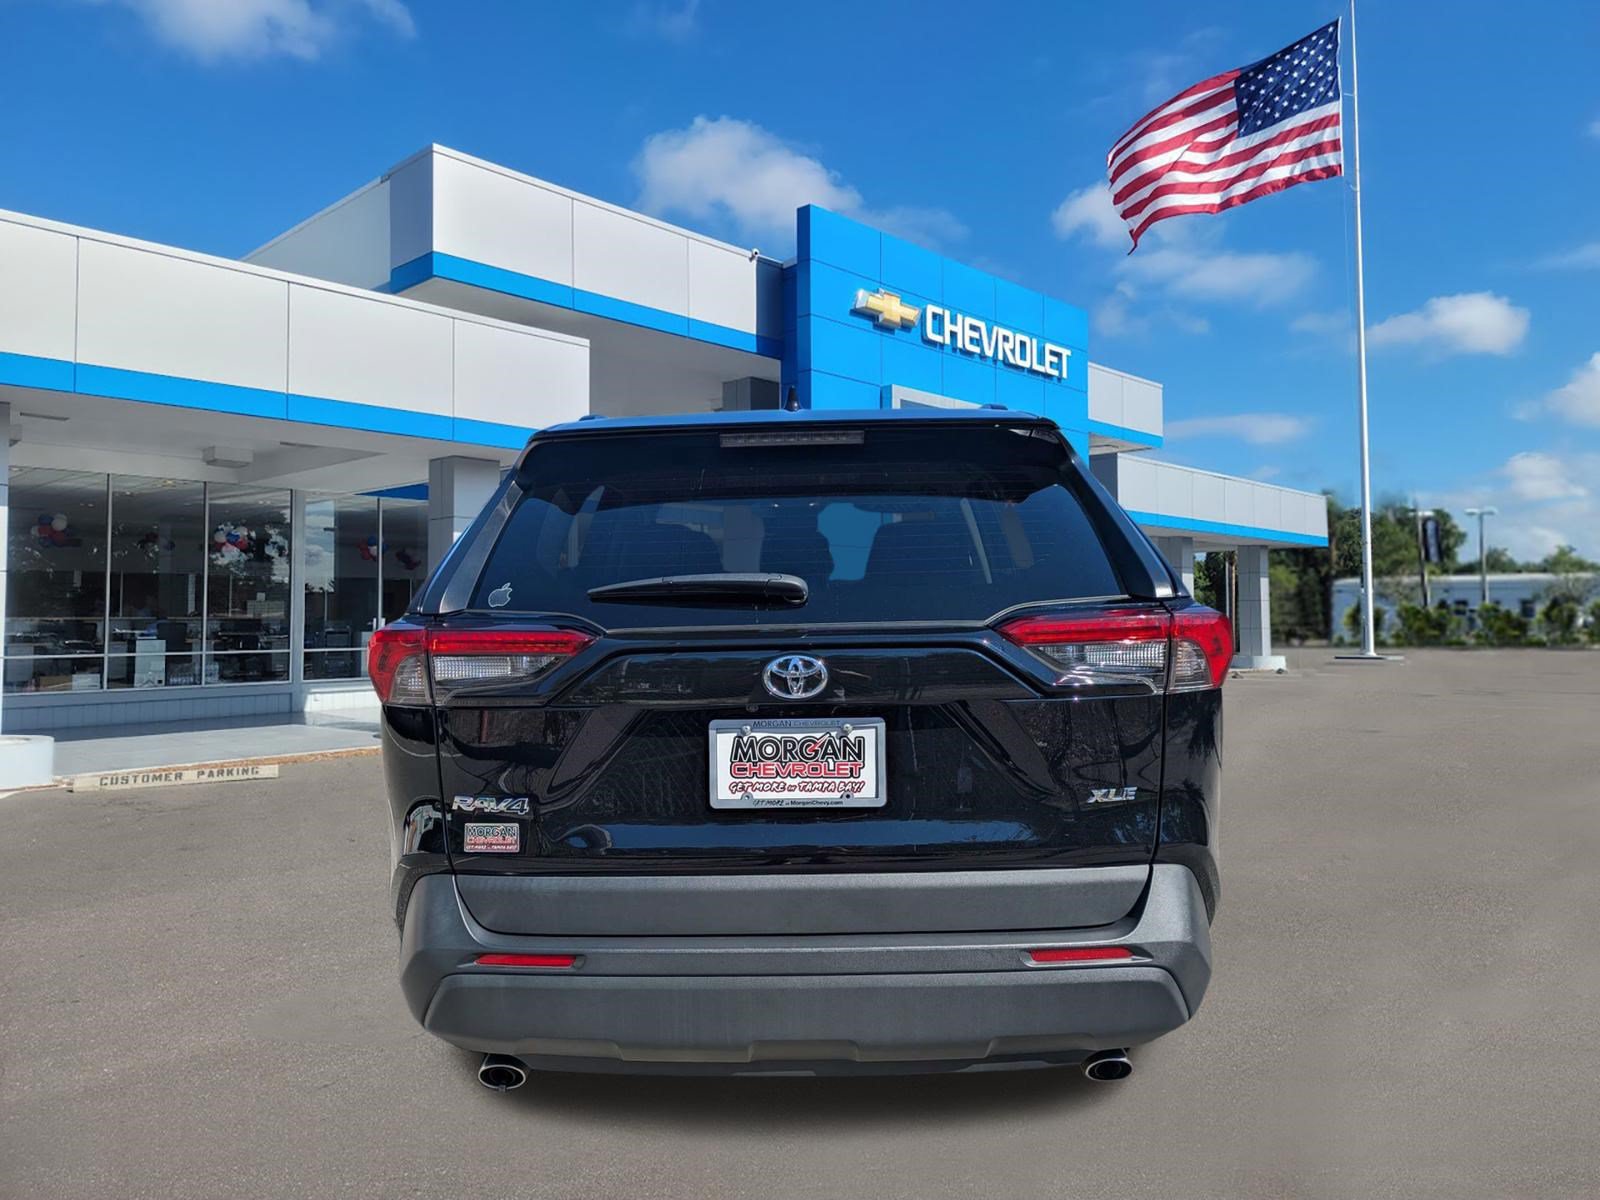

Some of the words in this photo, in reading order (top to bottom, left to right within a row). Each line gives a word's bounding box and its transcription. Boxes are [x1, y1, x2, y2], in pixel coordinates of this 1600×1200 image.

[925, 304, 1072, 379] CHEVROLET
[753, 720, 792, 728] MORGAN
[731, 733, 865, 762] MORGAN
[100, 771, 183, 786] CUSTOMER
[197, 766, 259, 779] PARKING
[731, 761, 864, 778] CHEVROLET
[729, 781, 752, 794] GET
[752, 781, 786, 793] MORE
[798, 781, 836, 793] TAMPA
[837, 781, 865, 794] BAY!
[1087, 786, 1137, 803] XLE
[452, 796, 529, 815] RAV4
[468, 826, 517, 837] MORGAN
